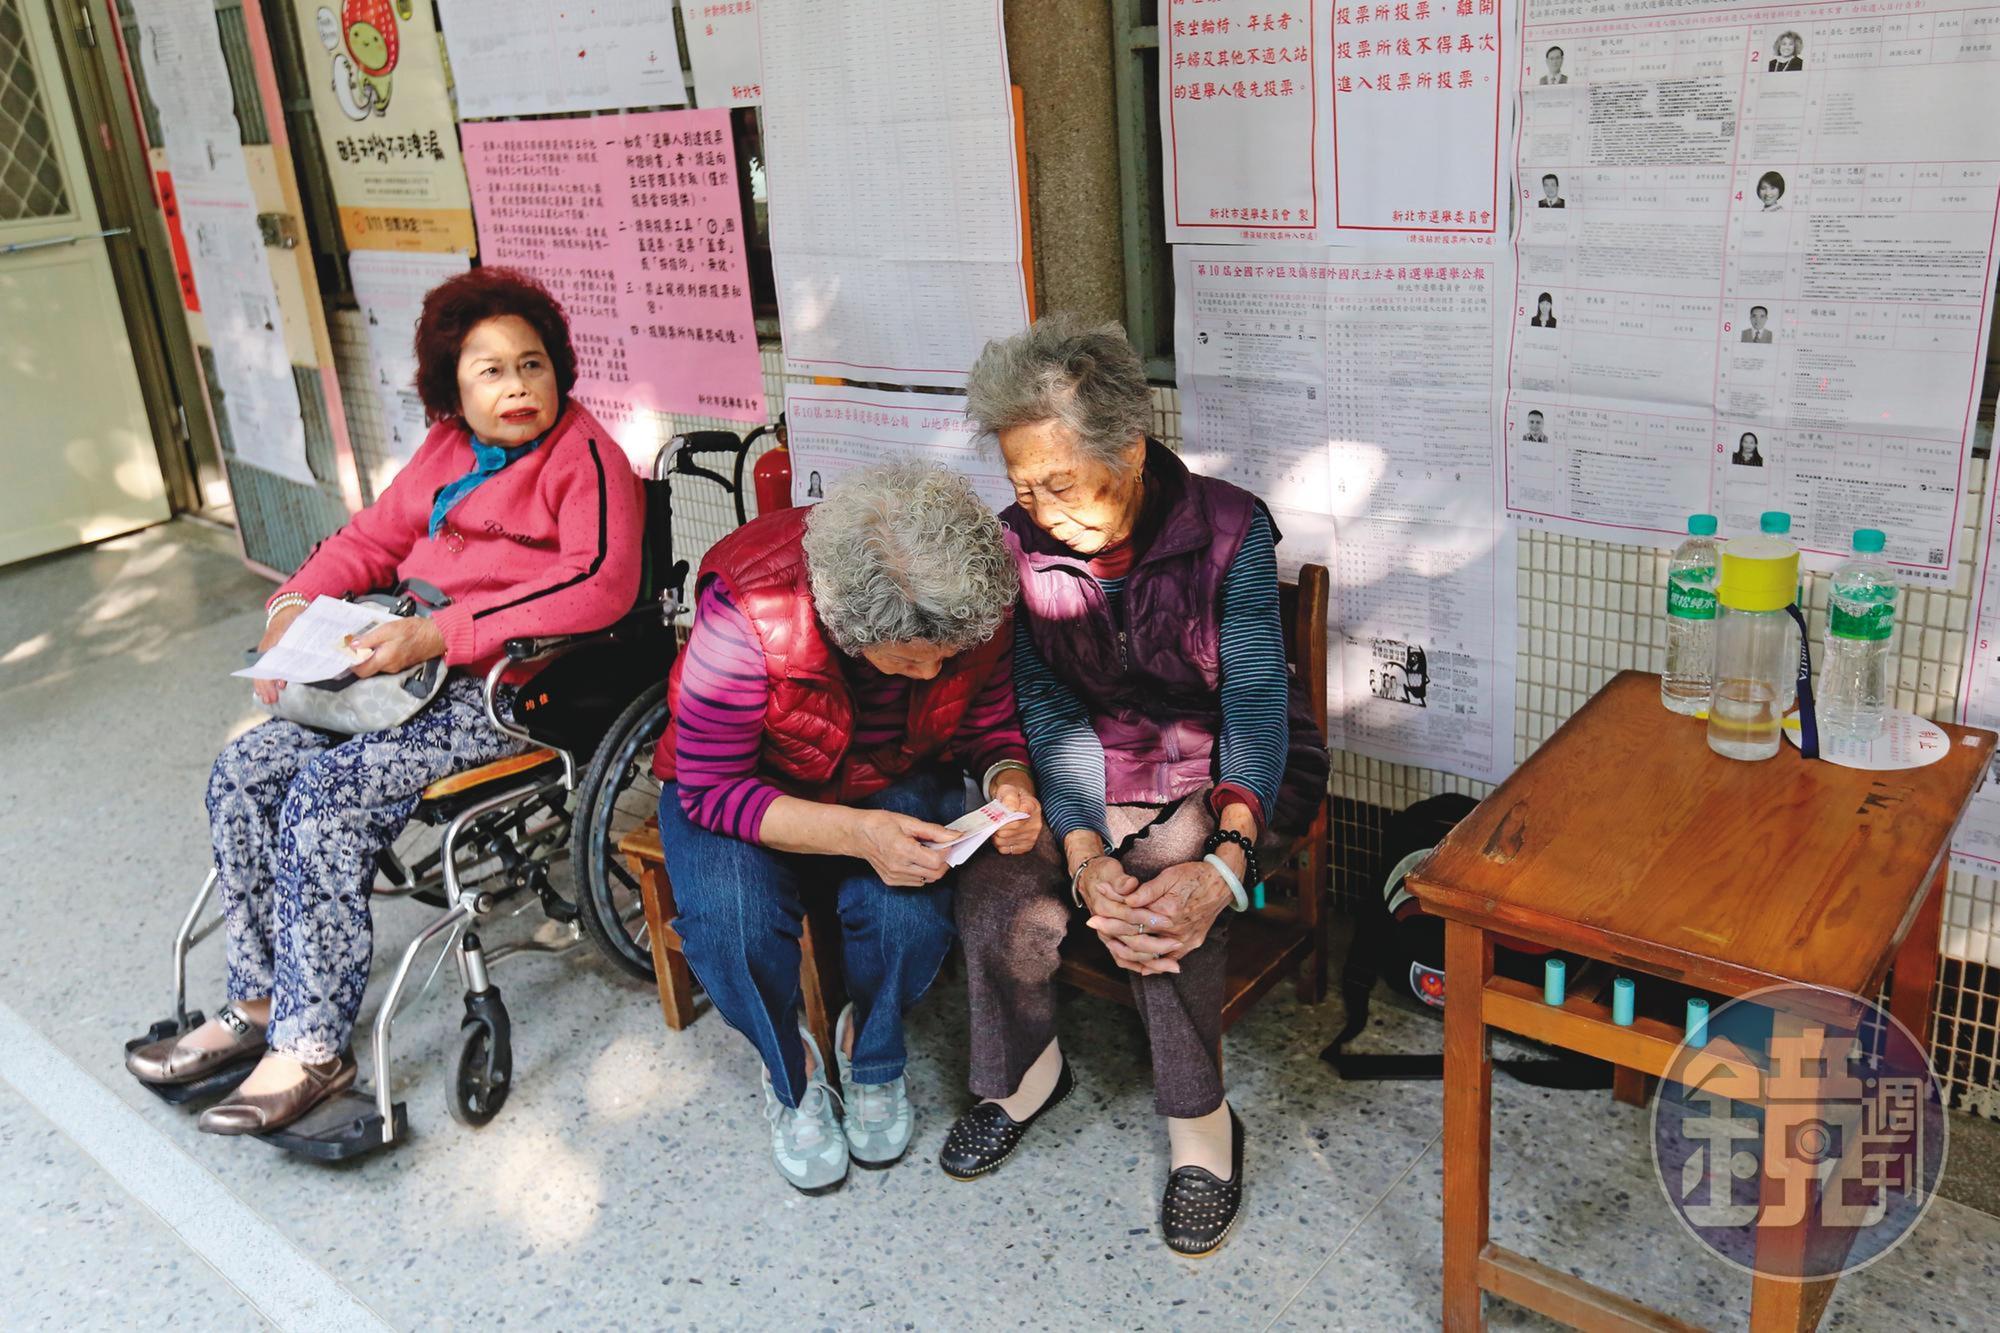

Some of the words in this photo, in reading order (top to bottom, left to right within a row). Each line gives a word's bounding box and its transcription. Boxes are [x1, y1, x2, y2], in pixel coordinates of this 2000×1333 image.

[1336, 0, 1494, 24] 投票所投票，離開
[1337, 33, 1495, 59] 投票所後不得再次
[1751, 51, 1759, 62] 2
[1525, 66, 1531, 76] 1
[1337, 70, 1489, 92] 進入投票所投票。
[1174, 79, 1305, 100] 的選舉人優先投票。
[1522, 189, 1530, 198] 3
[1735, 191, 1743, 201] 4
[1209, 208, 1291, 221] 新北市選舉委員會
[1392, 210, 1490, 224] 新北市選舉委員會
[1518, 307, 1525, 316] 5
[1723, 322, 1732, 332] 6
[1508, 422, 1515, 431] 7
[1716, 443, 1724, 454] 8
[1979, 639, 1988, 649] 5
